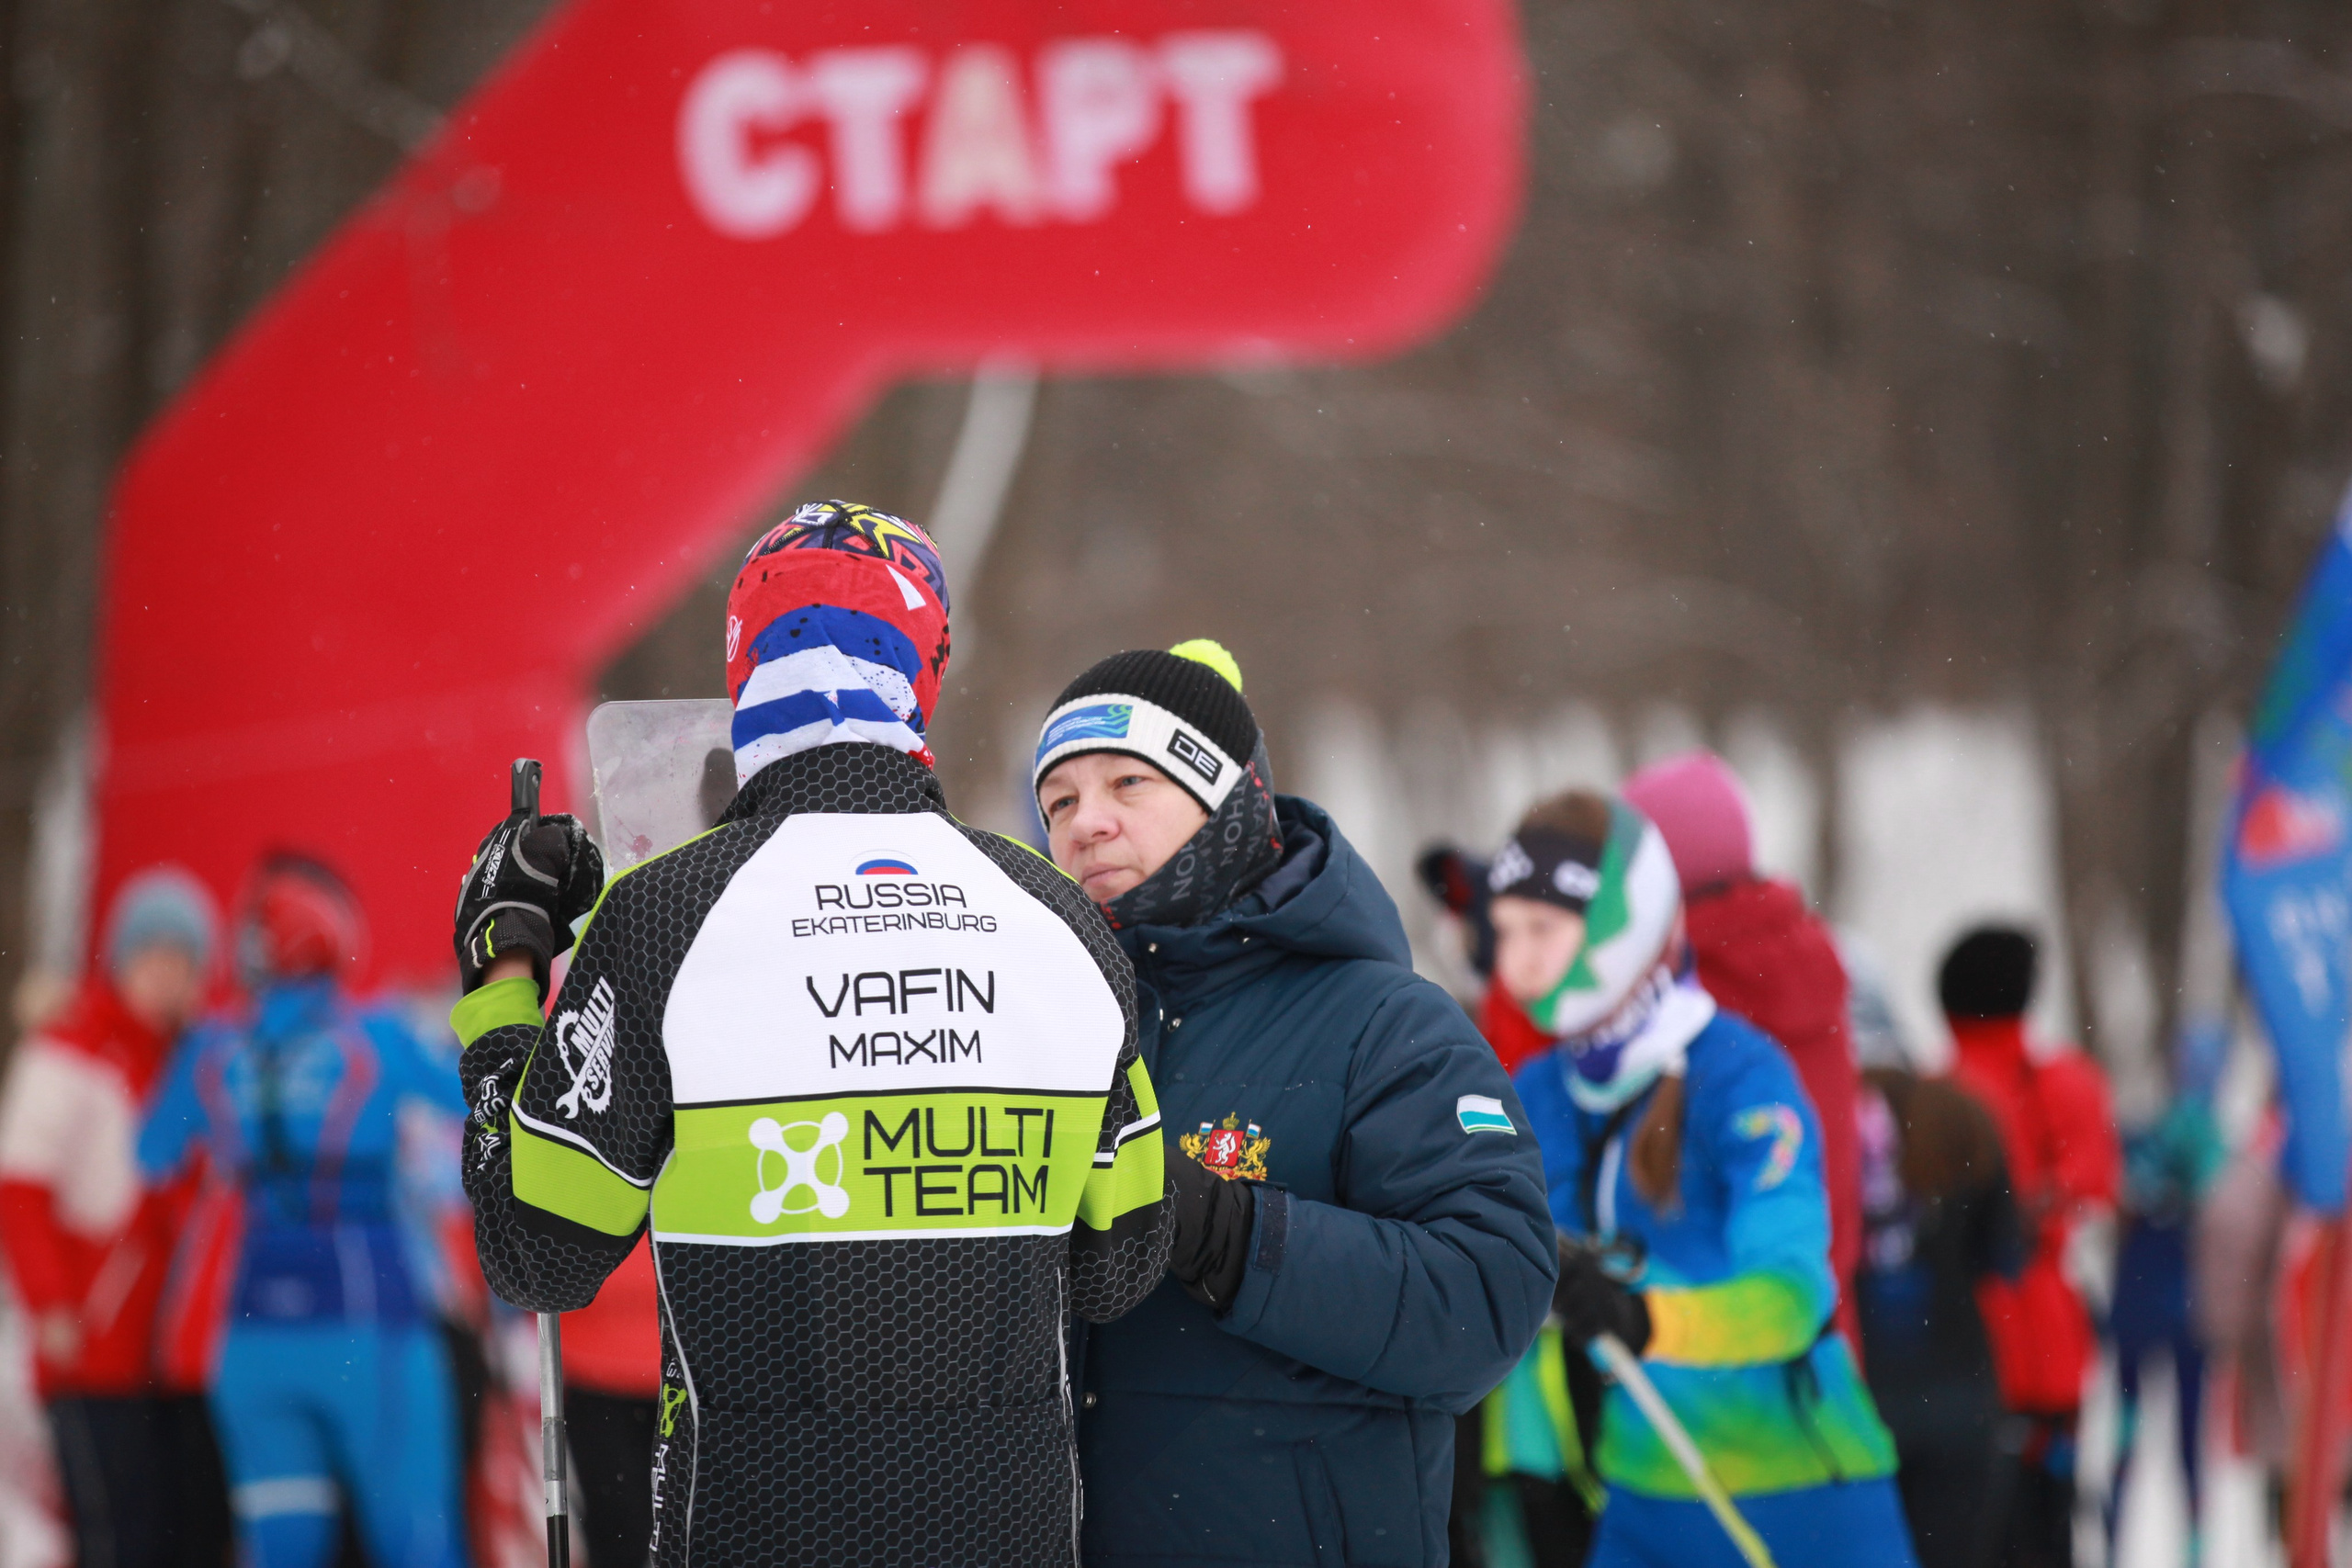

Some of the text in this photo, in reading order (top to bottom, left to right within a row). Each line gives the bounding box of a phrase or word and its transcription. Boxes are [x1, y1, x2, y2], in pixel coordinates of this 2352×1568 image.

[678, 30, 1281, 239] СТАРТ
[815, 882, 967, 910] RUSSIA
[791, 912, 997, 937] EKATERINBURG
[570, 976, 615, 1058] MULTI
[806, 967, 995, 1018] VAFIN
[829, 1028, 982, 1068] MAXIM
[863, 1106, 1055, 1160] MULTI
[863, 1164, 1049, 1217] TEAM
